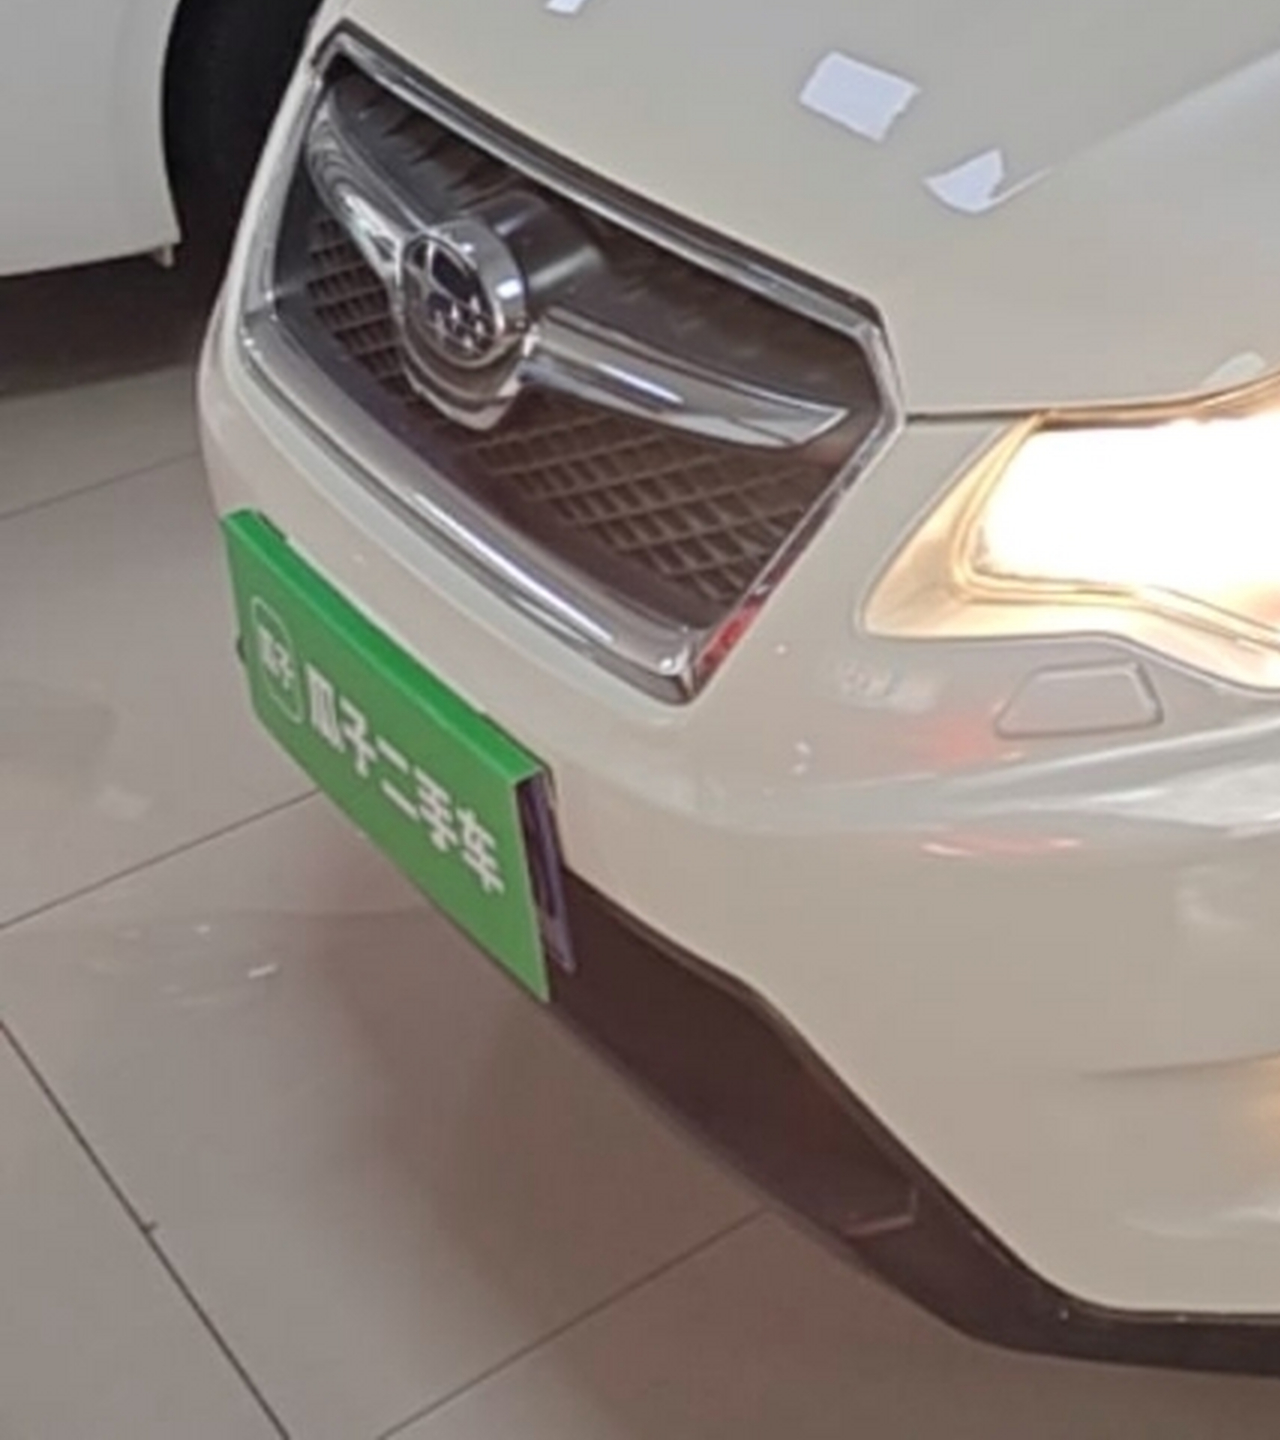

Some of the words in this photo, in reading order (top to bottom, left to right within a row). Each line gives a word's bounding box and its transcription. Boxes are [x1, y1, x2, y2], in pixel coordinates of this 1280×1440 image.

[304, 661, 506, 895] 瓜子二手车
